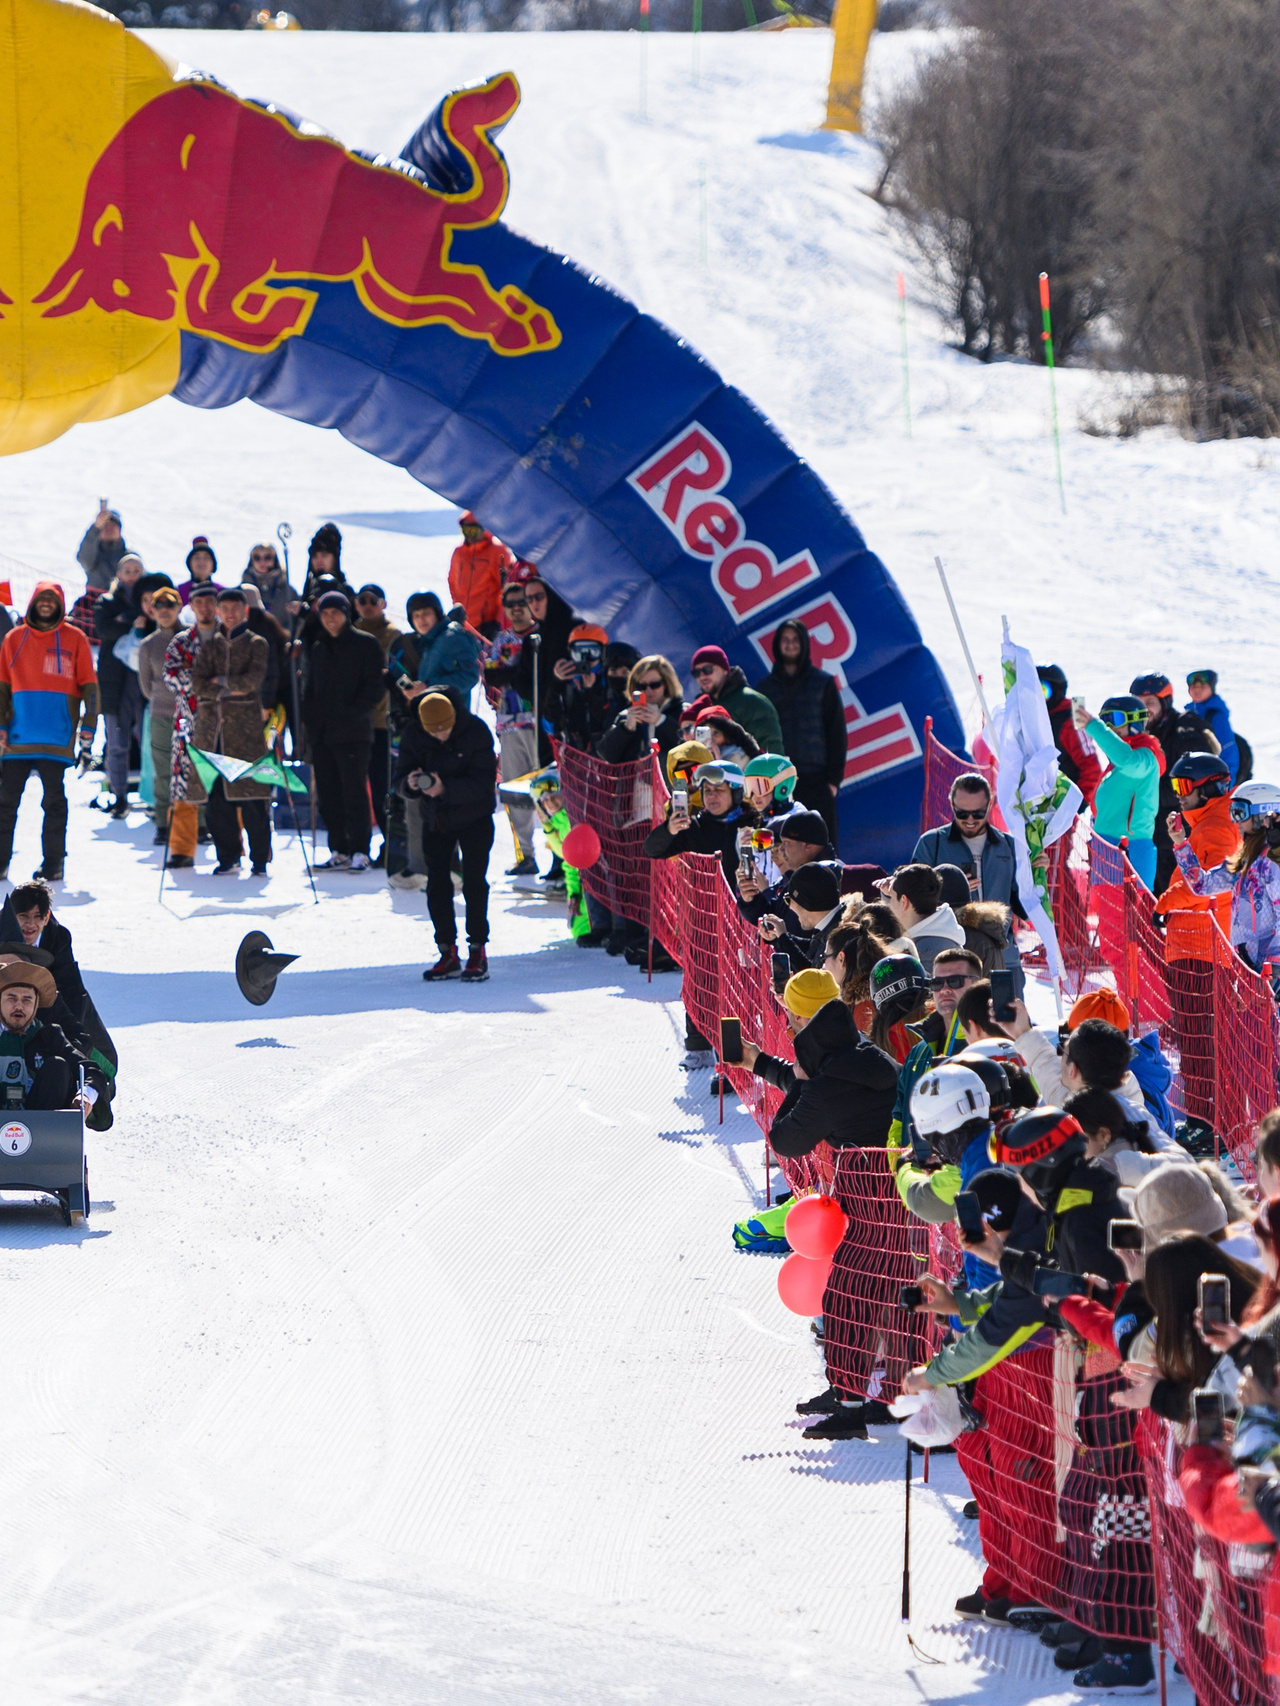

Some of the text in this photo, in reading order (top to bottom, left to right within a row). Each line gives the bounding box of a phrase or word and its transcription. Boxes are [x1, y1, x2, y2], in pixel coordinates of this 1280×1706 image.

[630, 424, 919, 785] Red Bll
[11, 1139, 18, 1151] 6
